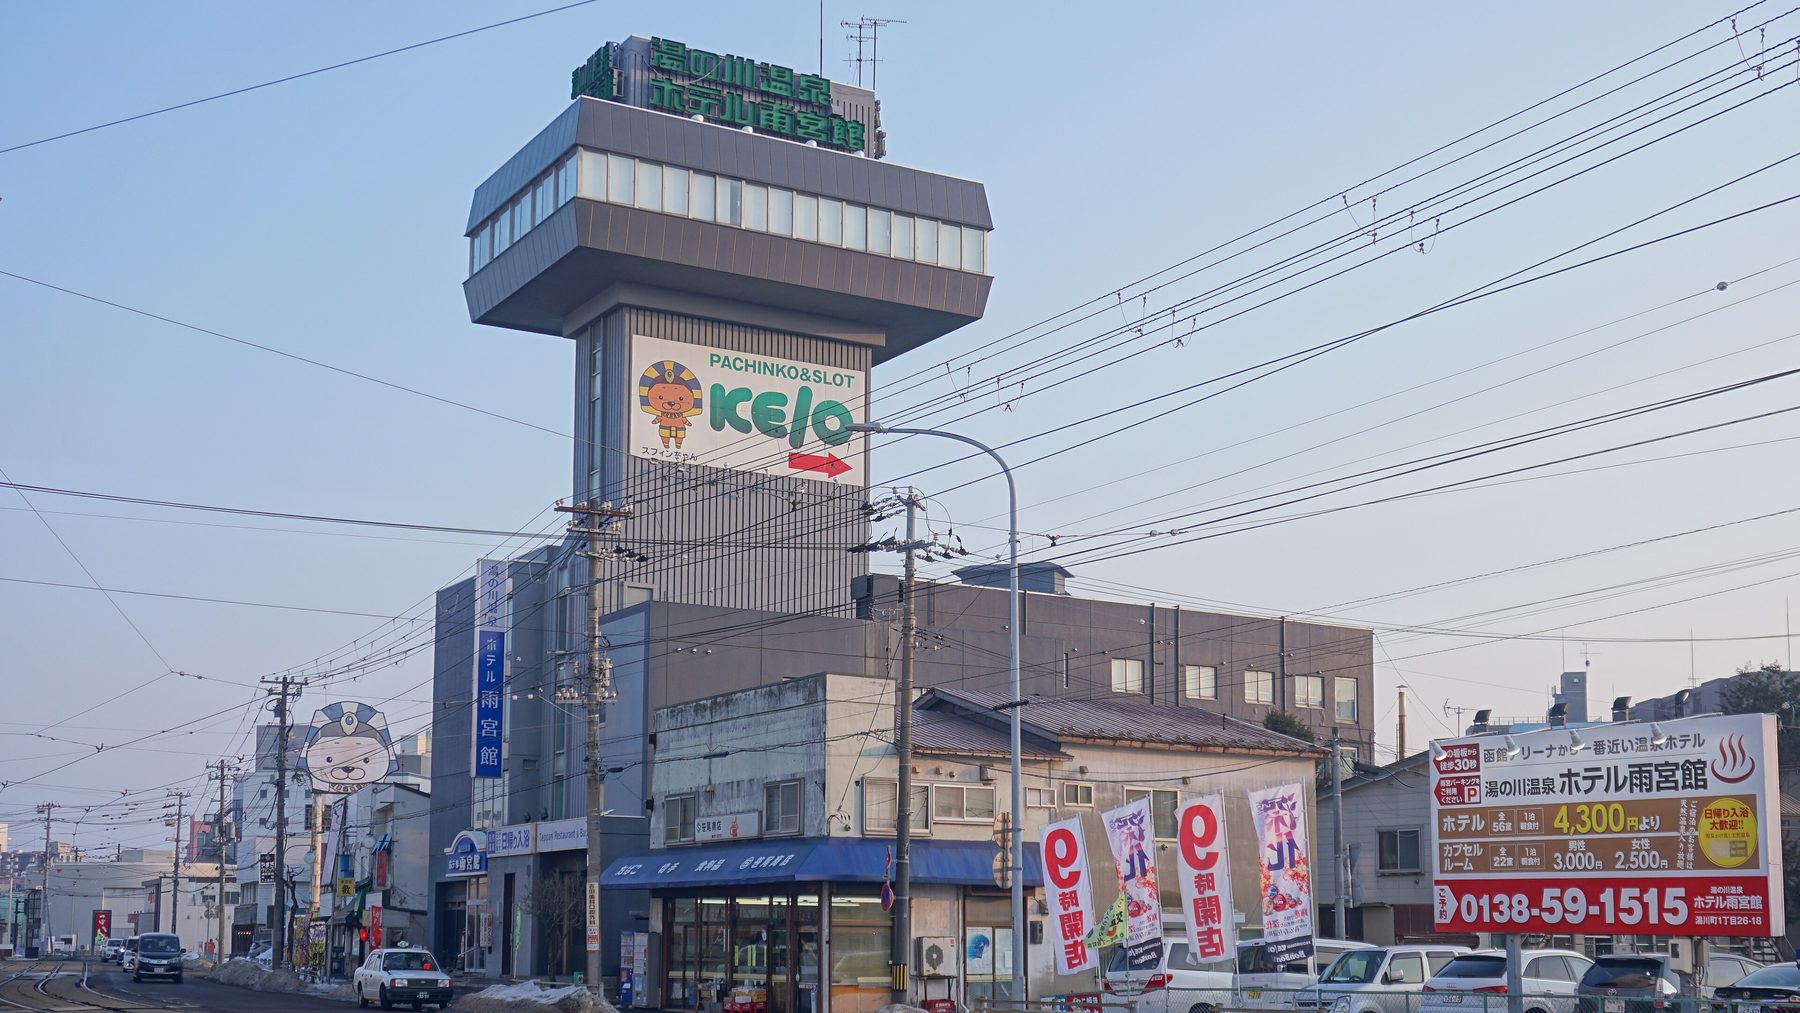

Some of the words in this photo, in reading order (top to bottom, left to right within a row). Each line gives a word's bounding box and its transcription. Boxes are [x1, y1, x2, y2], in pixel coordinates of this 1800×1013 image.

[650, 36, 832, 106] 湯の川温泉
[649, 78, 865, 150] ホテル雨宮館
[710, 353, 855, 388] PACHINKO&SLOT
[487, 565, 499, 627] 湯の川温泉
[480, 638, 499, 766] ホテル雨宮館
[1440, 758, 1477, 771] 徒歩30秒
[1485, 777, 1556, 798] 湯の川温泉
[1559, 758, 1708, 796] ホテル雨宮館
[1524, 812, 1536, 821] 1泊
[1705, 807, 1750, 819] 日帰り入浴
[1442, 814, 1485, 832] ホテル
[501, 829, 530, 850] 日帰り入浴
[1568, 840, 1586, 851] 男性
[1631, 838, 1650, 849] 女性
[1525, 847, 1537, 856] 1泊
[1615, 850, 1669, 870] 2,500円
[1444, 857, 1474, 871] ルーム
[1553, 852, 1603, 871] 3,000円
[1710, 886, 1744, 894] 湯の川温泉
[1460, 888, 1689, 925] 0138-59-1515
[1694, 896, 1763, 910] ホテル雨宮館
